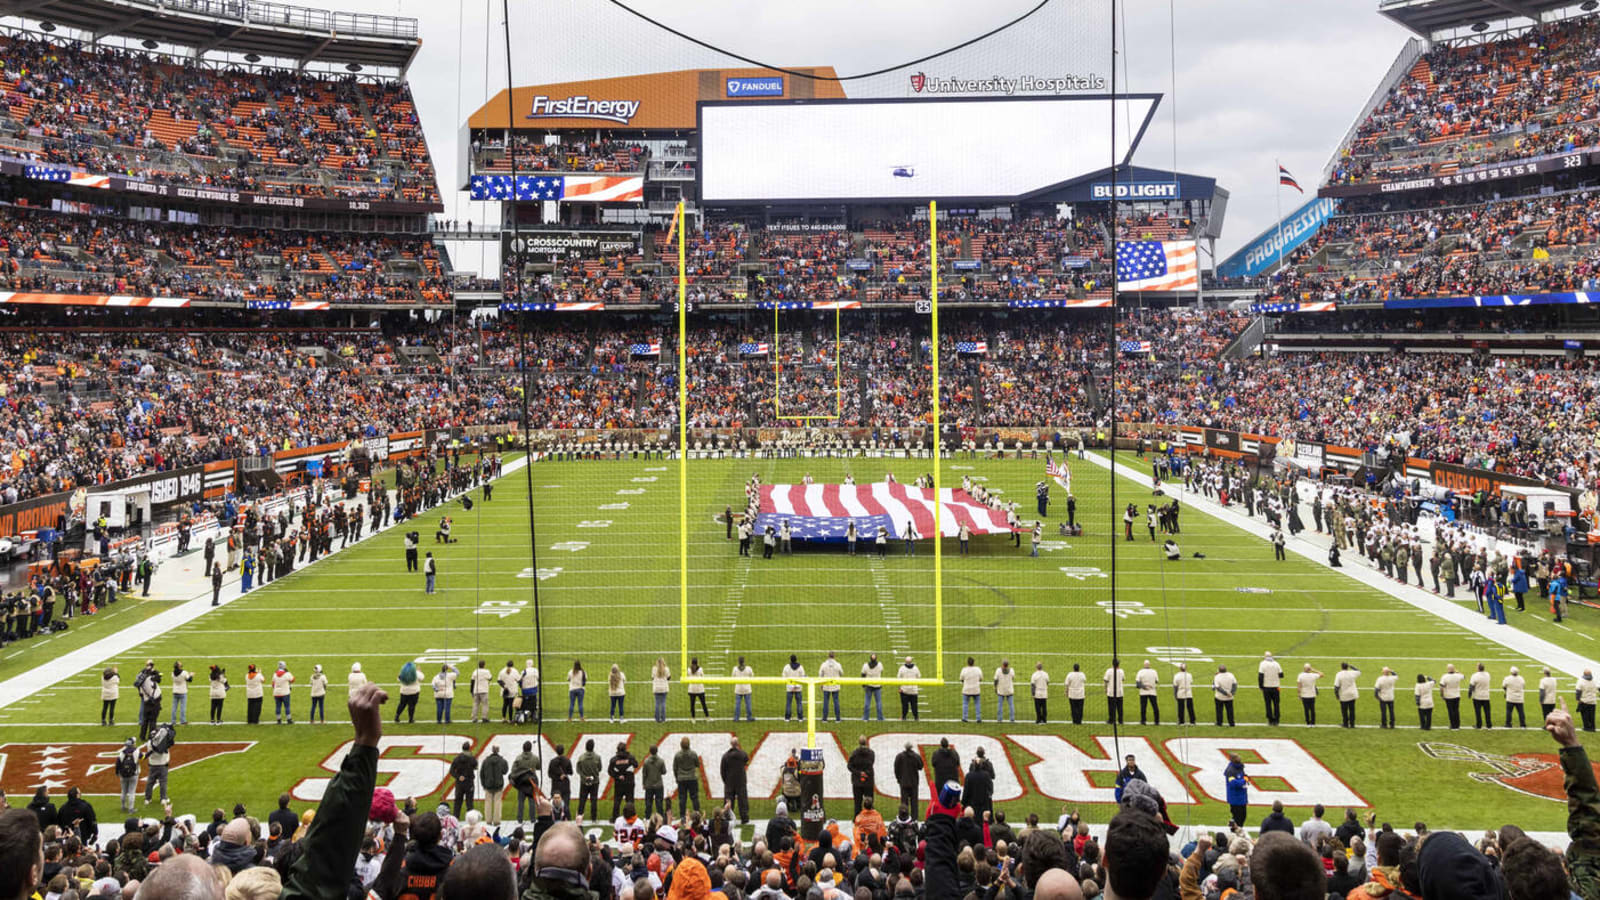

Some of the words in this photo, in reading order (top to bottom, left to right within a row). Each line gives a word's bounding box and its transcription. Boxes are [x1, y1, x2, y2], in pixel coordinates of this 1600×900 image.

[742, 82, 782, 91] FANDUEL
[927, 77, 1017, 94] University
[1020, 74, 1105, 93] Hospitals
[531, 95, 640, 118] FirstEnergy
[1094, 185, 1128, 197] BUD
[1129, 184, 1176, 197] LIGHT
[1381, 178, 1435, 192] CHAMPIONSHIPS
[253, 195, 267, 204] MAC
[526, 238, 598, 248] CROSSCOUNTRY
[180, 472, 201, 496] 1946
[17, 501, 67, 536] BROWNS
[408, 875, 437, 888] CHUBB
